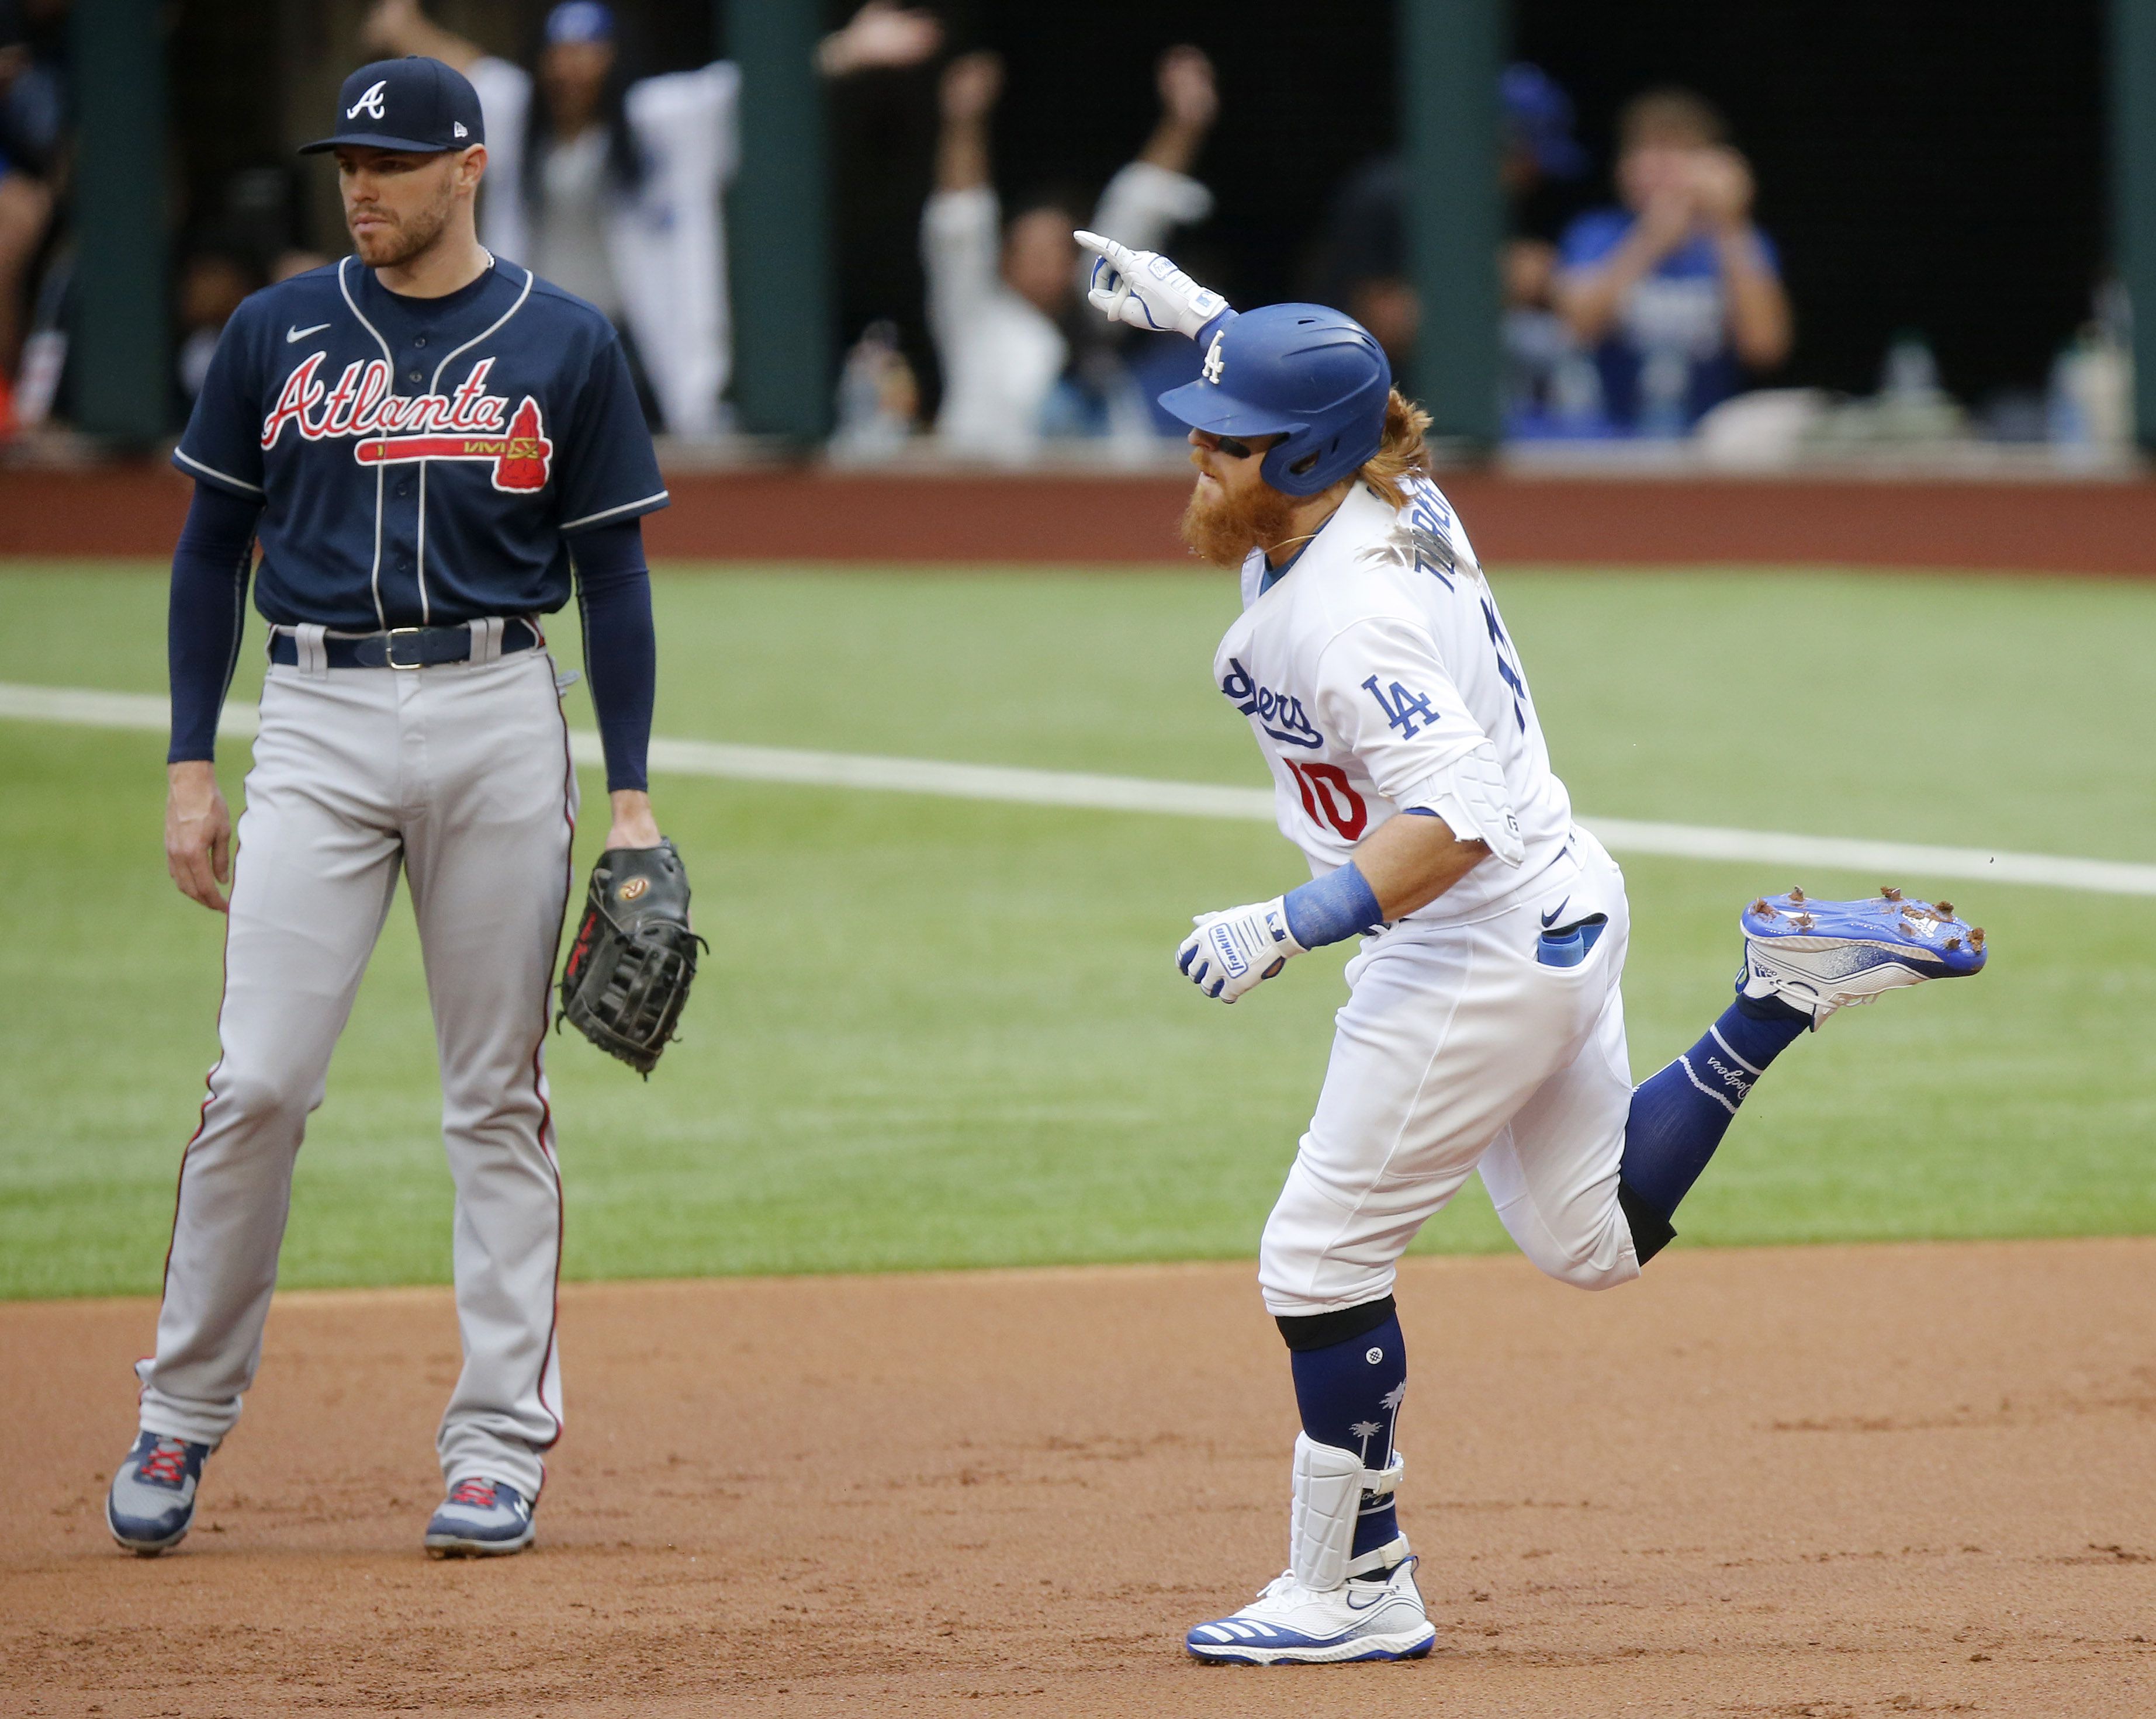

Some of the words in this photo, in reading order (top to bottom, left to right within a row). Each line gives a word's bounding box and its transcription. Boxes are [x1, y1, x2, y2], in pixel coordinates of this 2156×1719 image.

[347, 80, 387, 119] A
[1202, 329, 1225, 384] LA
[261, 351, 509, 450] Atlanta
[1361, 674, 1441, 741] LA
[1282, 757, 1368, 841] 10
[1707, 1056, 1753, 1100] Dodgers
